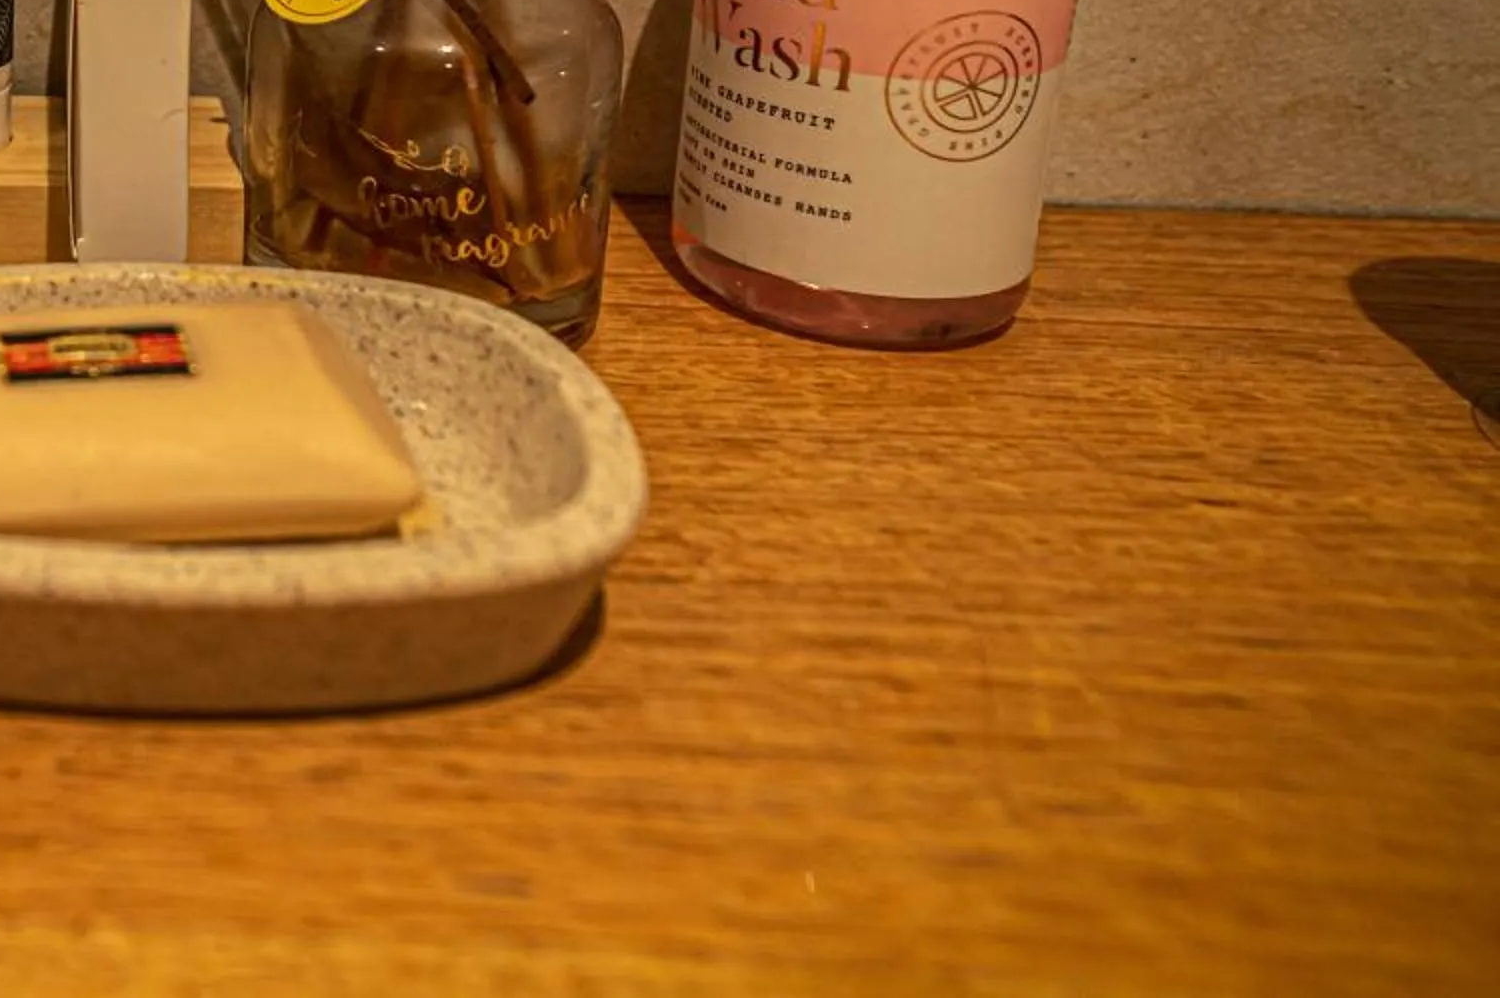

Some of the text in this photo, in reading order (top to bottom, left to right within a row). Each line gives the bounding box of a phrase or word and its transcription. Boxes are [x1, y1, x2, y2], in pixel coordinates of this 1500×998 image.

[717, 85, 835, 130] GRAPEFRUIT
[775, 158, 852, 184] FORMULA
[713, 171, 783, 206] CLEANSES
[795, 201, 852, 222] HANDS
